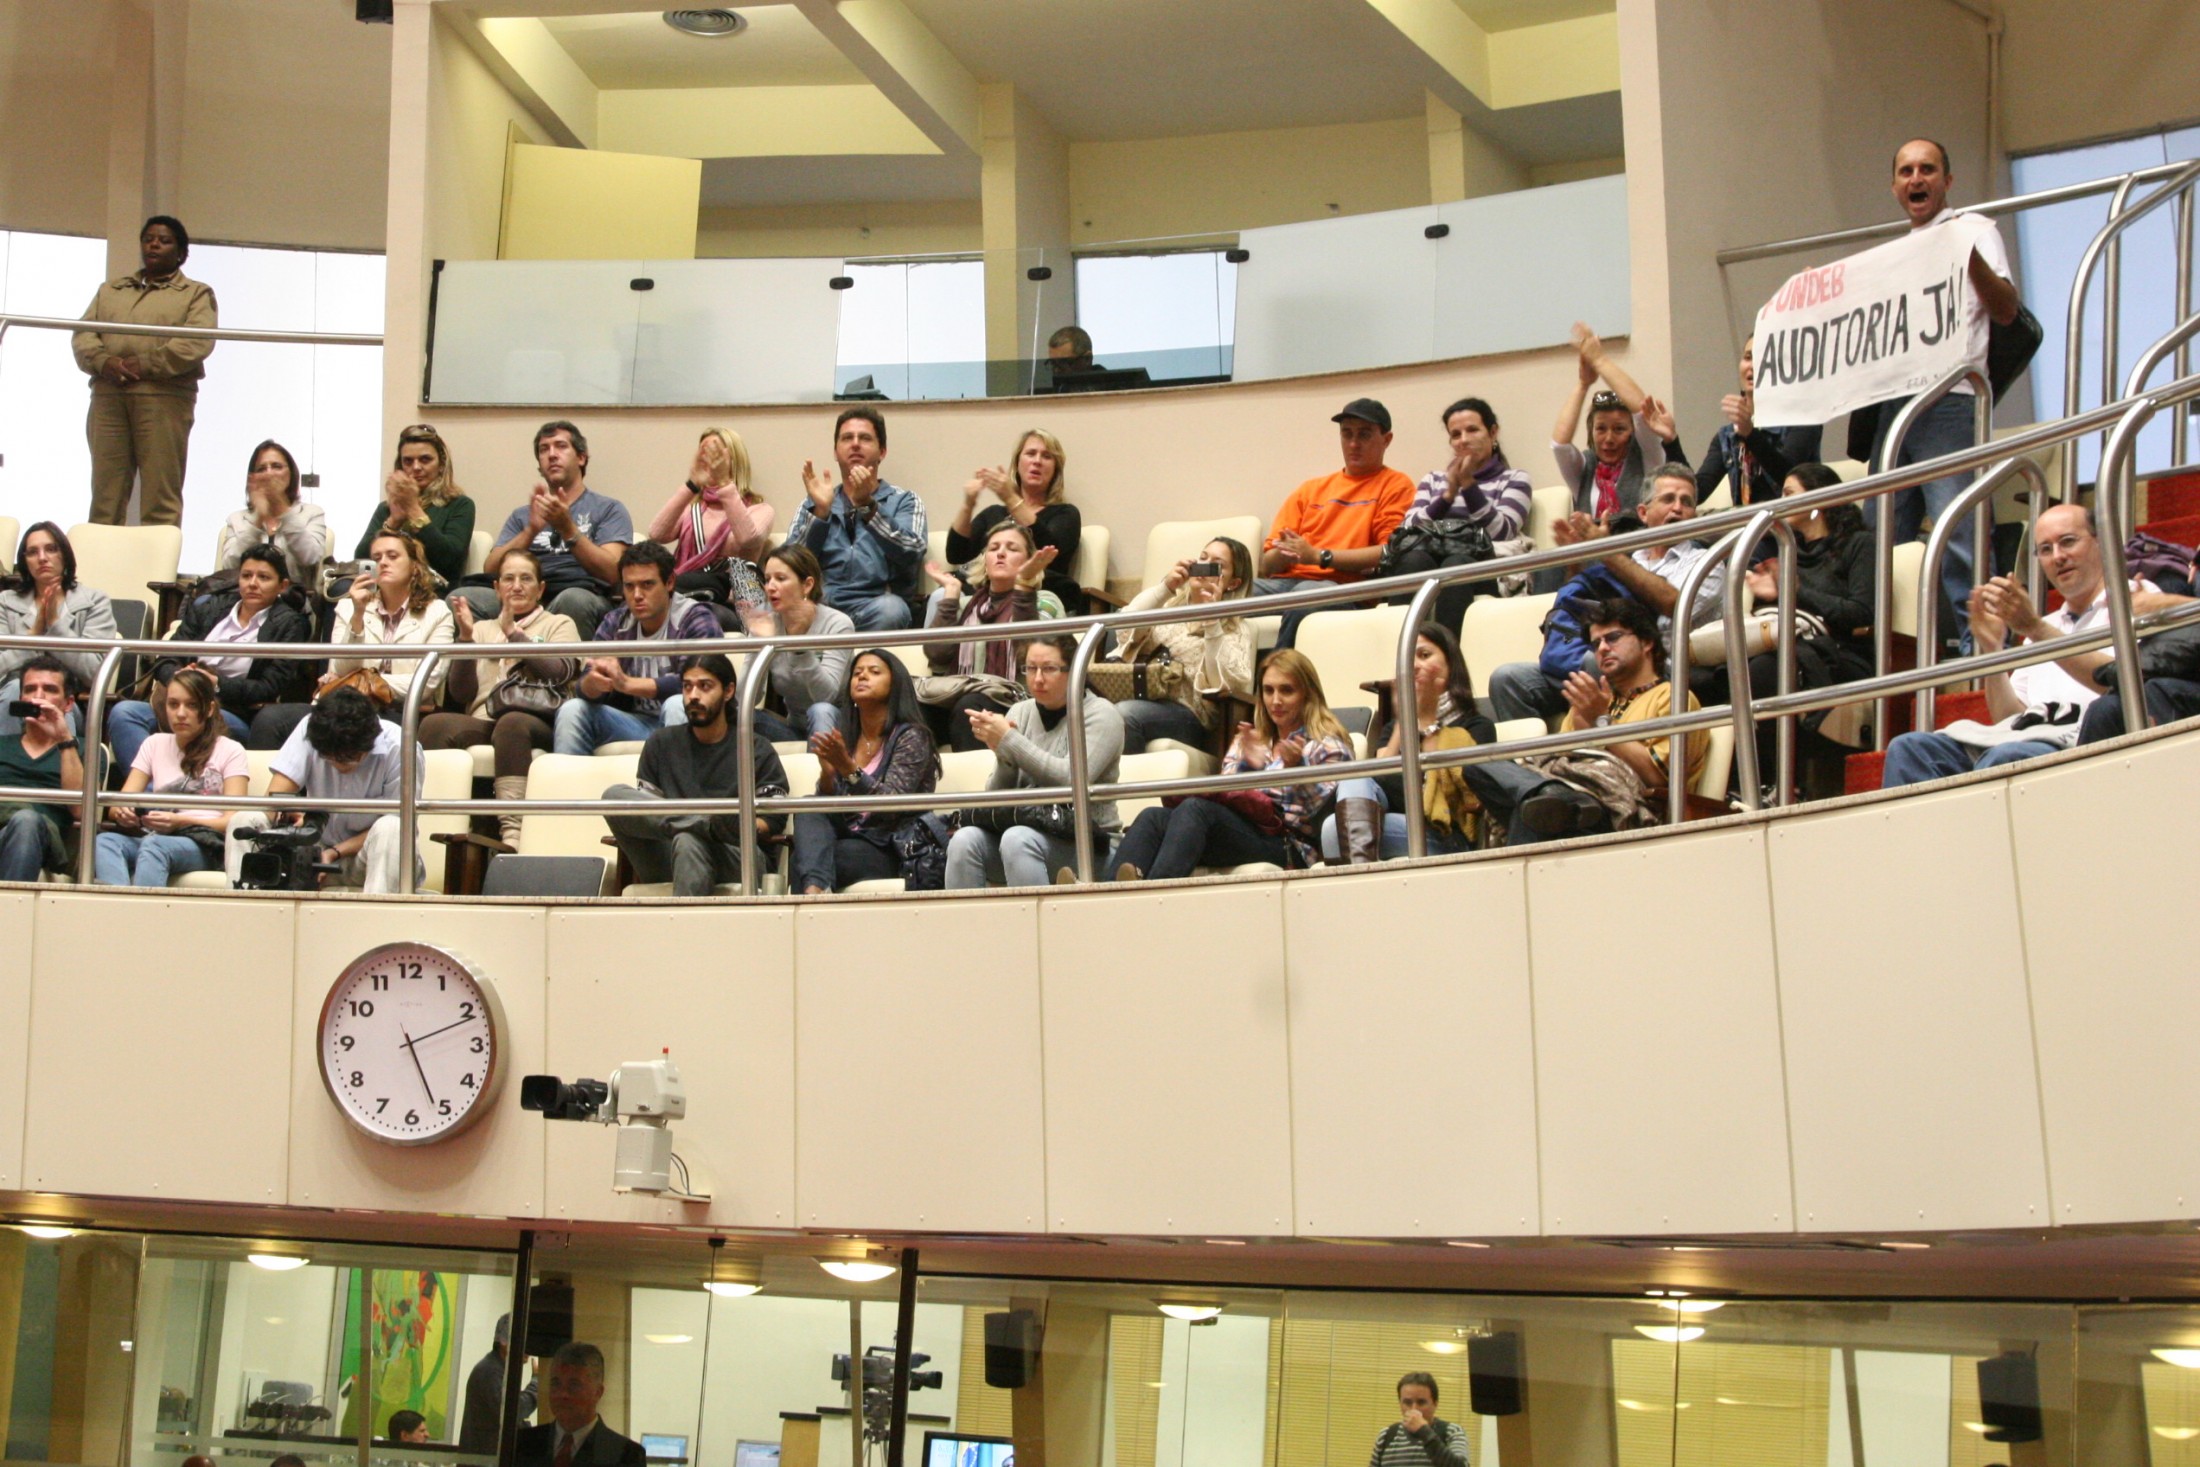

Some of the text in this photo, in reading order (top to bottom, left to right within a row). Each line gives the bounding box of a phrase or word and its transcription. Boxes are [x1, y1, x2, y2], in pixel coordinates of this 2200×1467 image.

[1755, 293, 1909, 389] AUDITORIA
[397, 962, 423, 979] 12
[370, 974, 389, 991] 11
[437, 975, 446, 991] 1
[348, 1000, 374, 1017] 10
[459, 1002, 474, 1018] 2
[340, 1035, 355, 1052] 9
[470, 1036, 484, 1053] 3
[350, 1071, 364, 1088] 8
[460, 1073, 475, 1089] 4
[376, 1098, 389, 1114] 7
[438, 1099, 452, 1116] 5
[404, 1109, 420, 1125] 6
